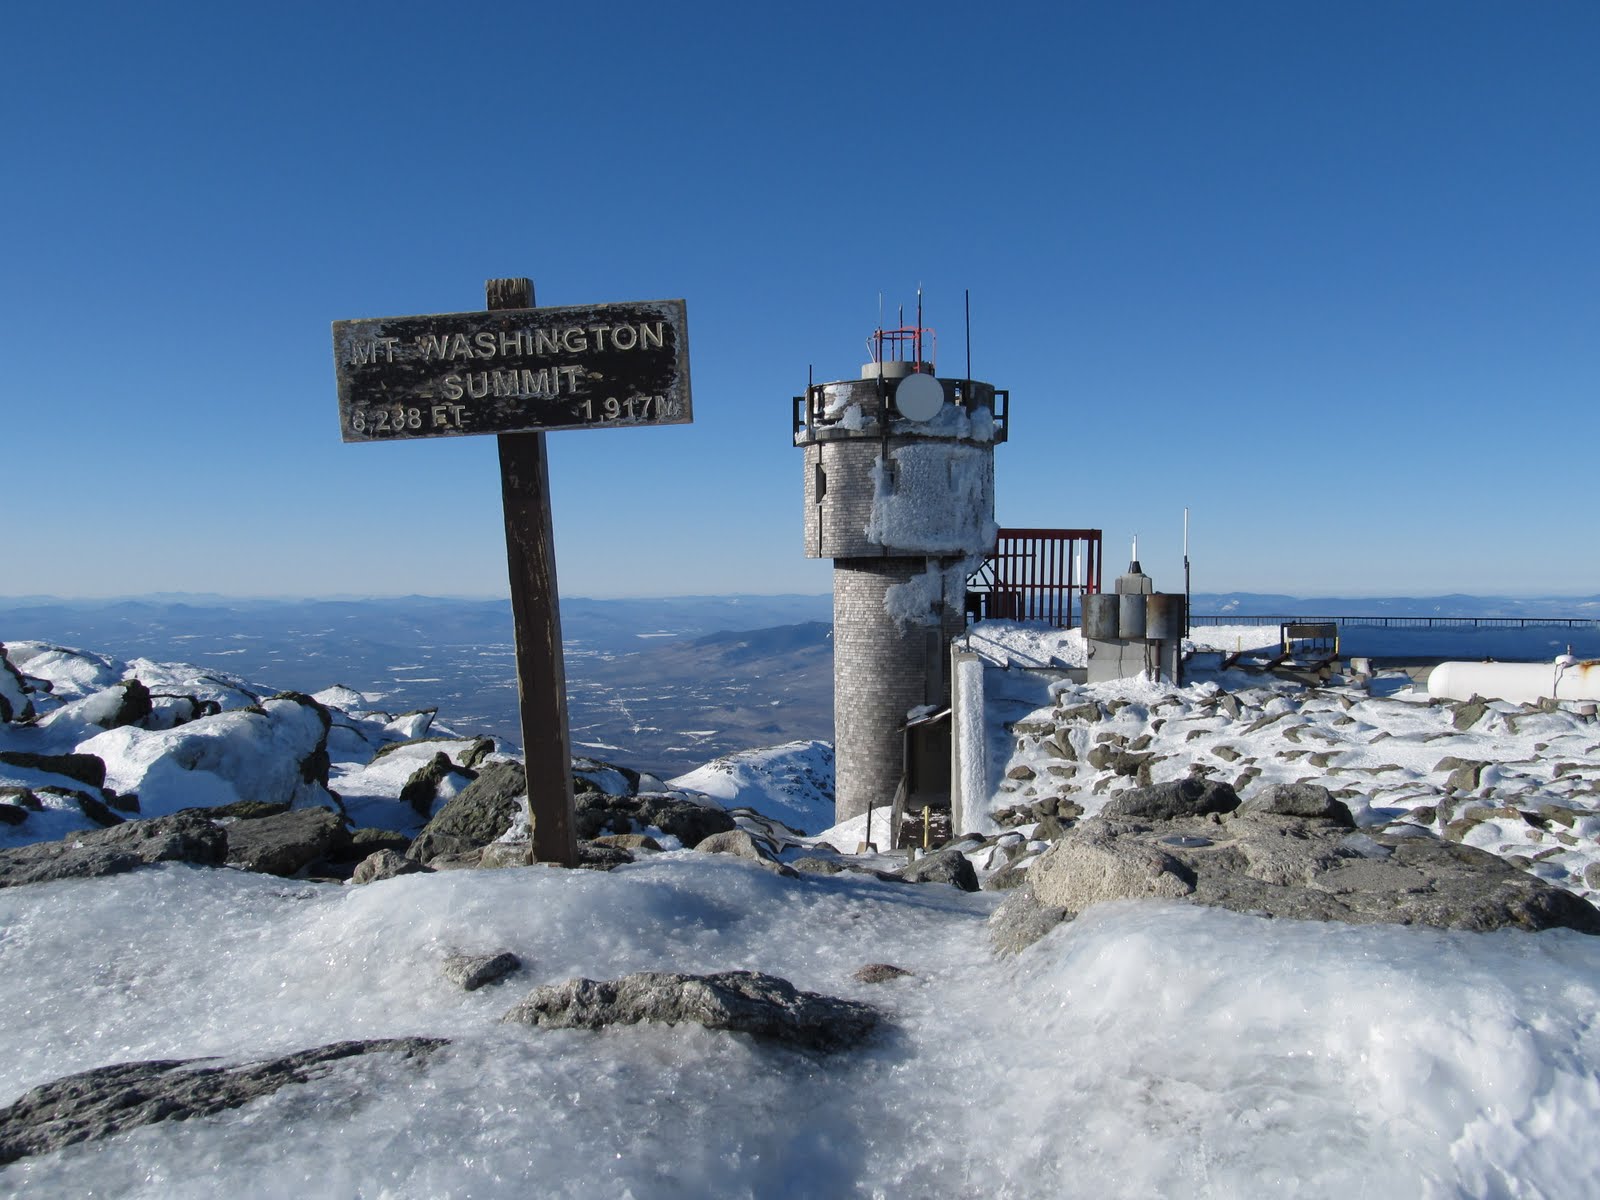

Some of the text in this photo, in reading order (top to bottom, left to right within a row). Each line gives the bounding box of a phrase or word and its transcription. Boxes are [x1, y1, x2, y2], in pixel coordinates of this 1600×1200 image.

[351, 322, 663, 365] MT WASHINGTON
[443, 365, 583, 400] SUMMIT
[431, 405, 466, 427] FT
